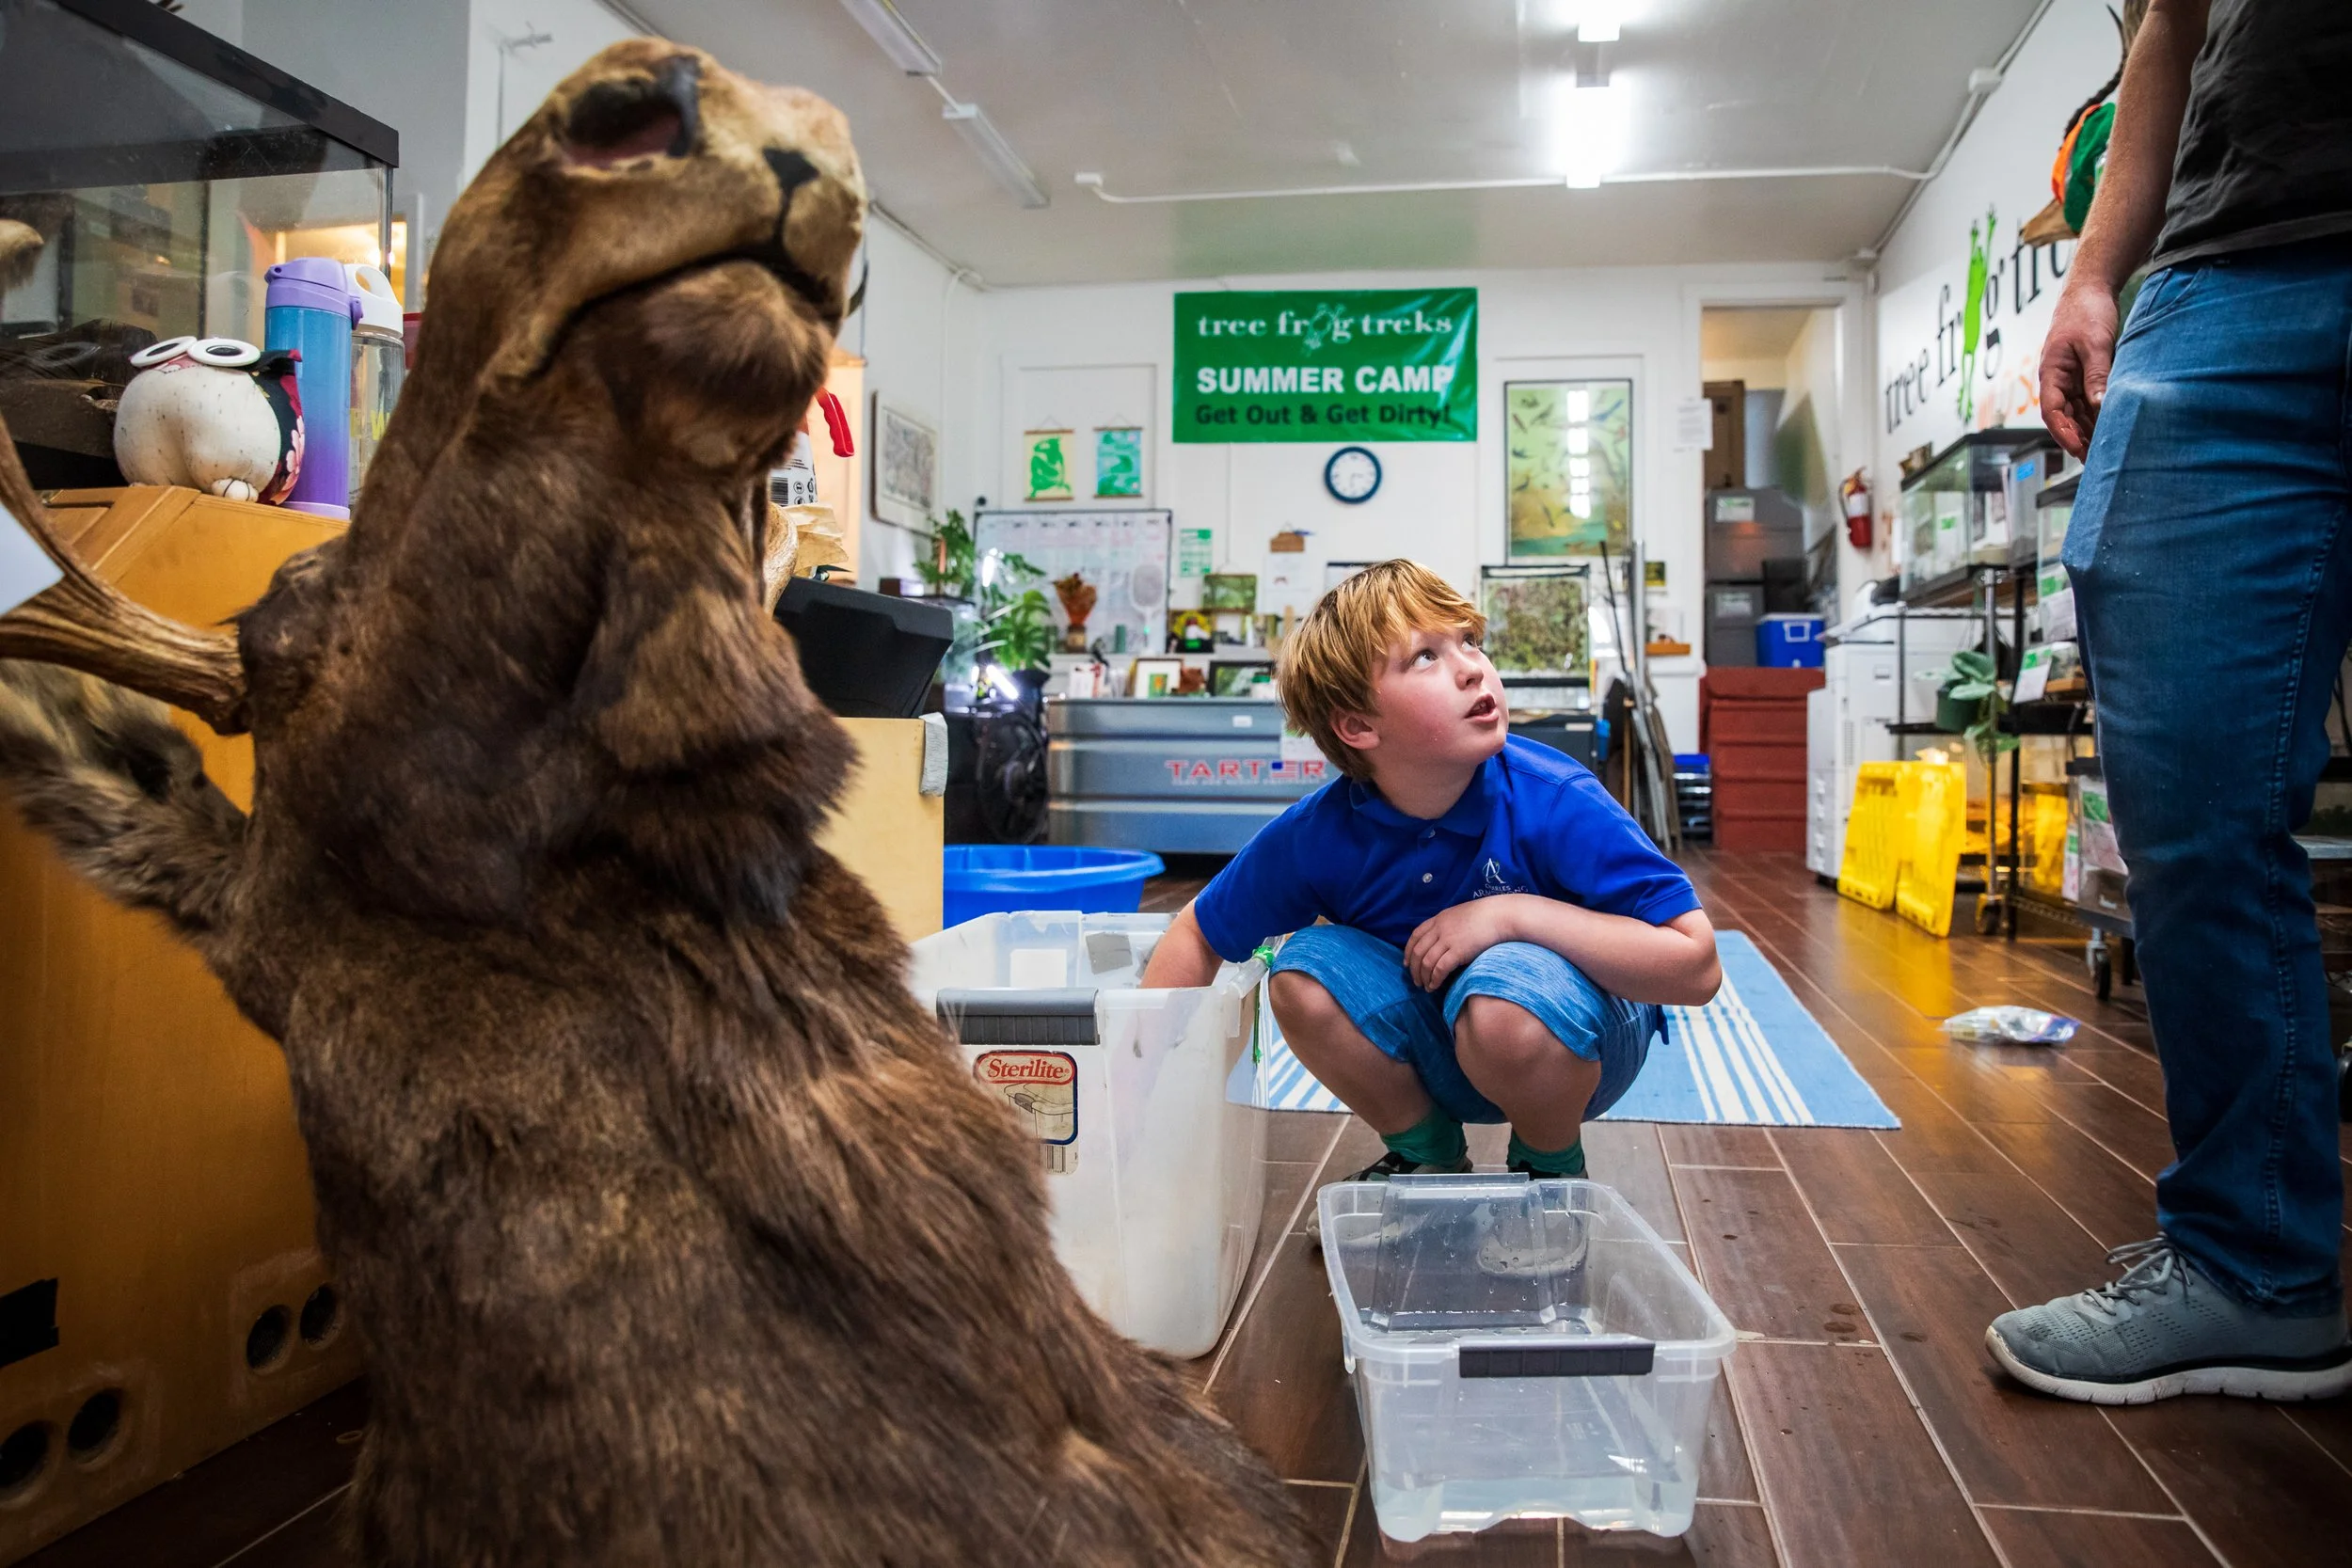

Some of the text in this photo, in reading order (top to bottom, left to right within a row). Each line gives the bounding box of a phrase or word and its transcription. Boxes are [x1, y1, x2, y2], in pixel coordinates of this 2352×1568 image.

[1197, 313, 1266, 337] tree
[1361, 309, 1453, 337] treks
[1197, 365, 1454, 394] SUMMER CAMP
[1884, 346, 1930, 435] tree
[1195, 403, 1452, 429] Get Out & Get Dirty!
[1165, 758, 1327, 780] TARTER
[987, 1058, 1064, 1079] Sterilite
